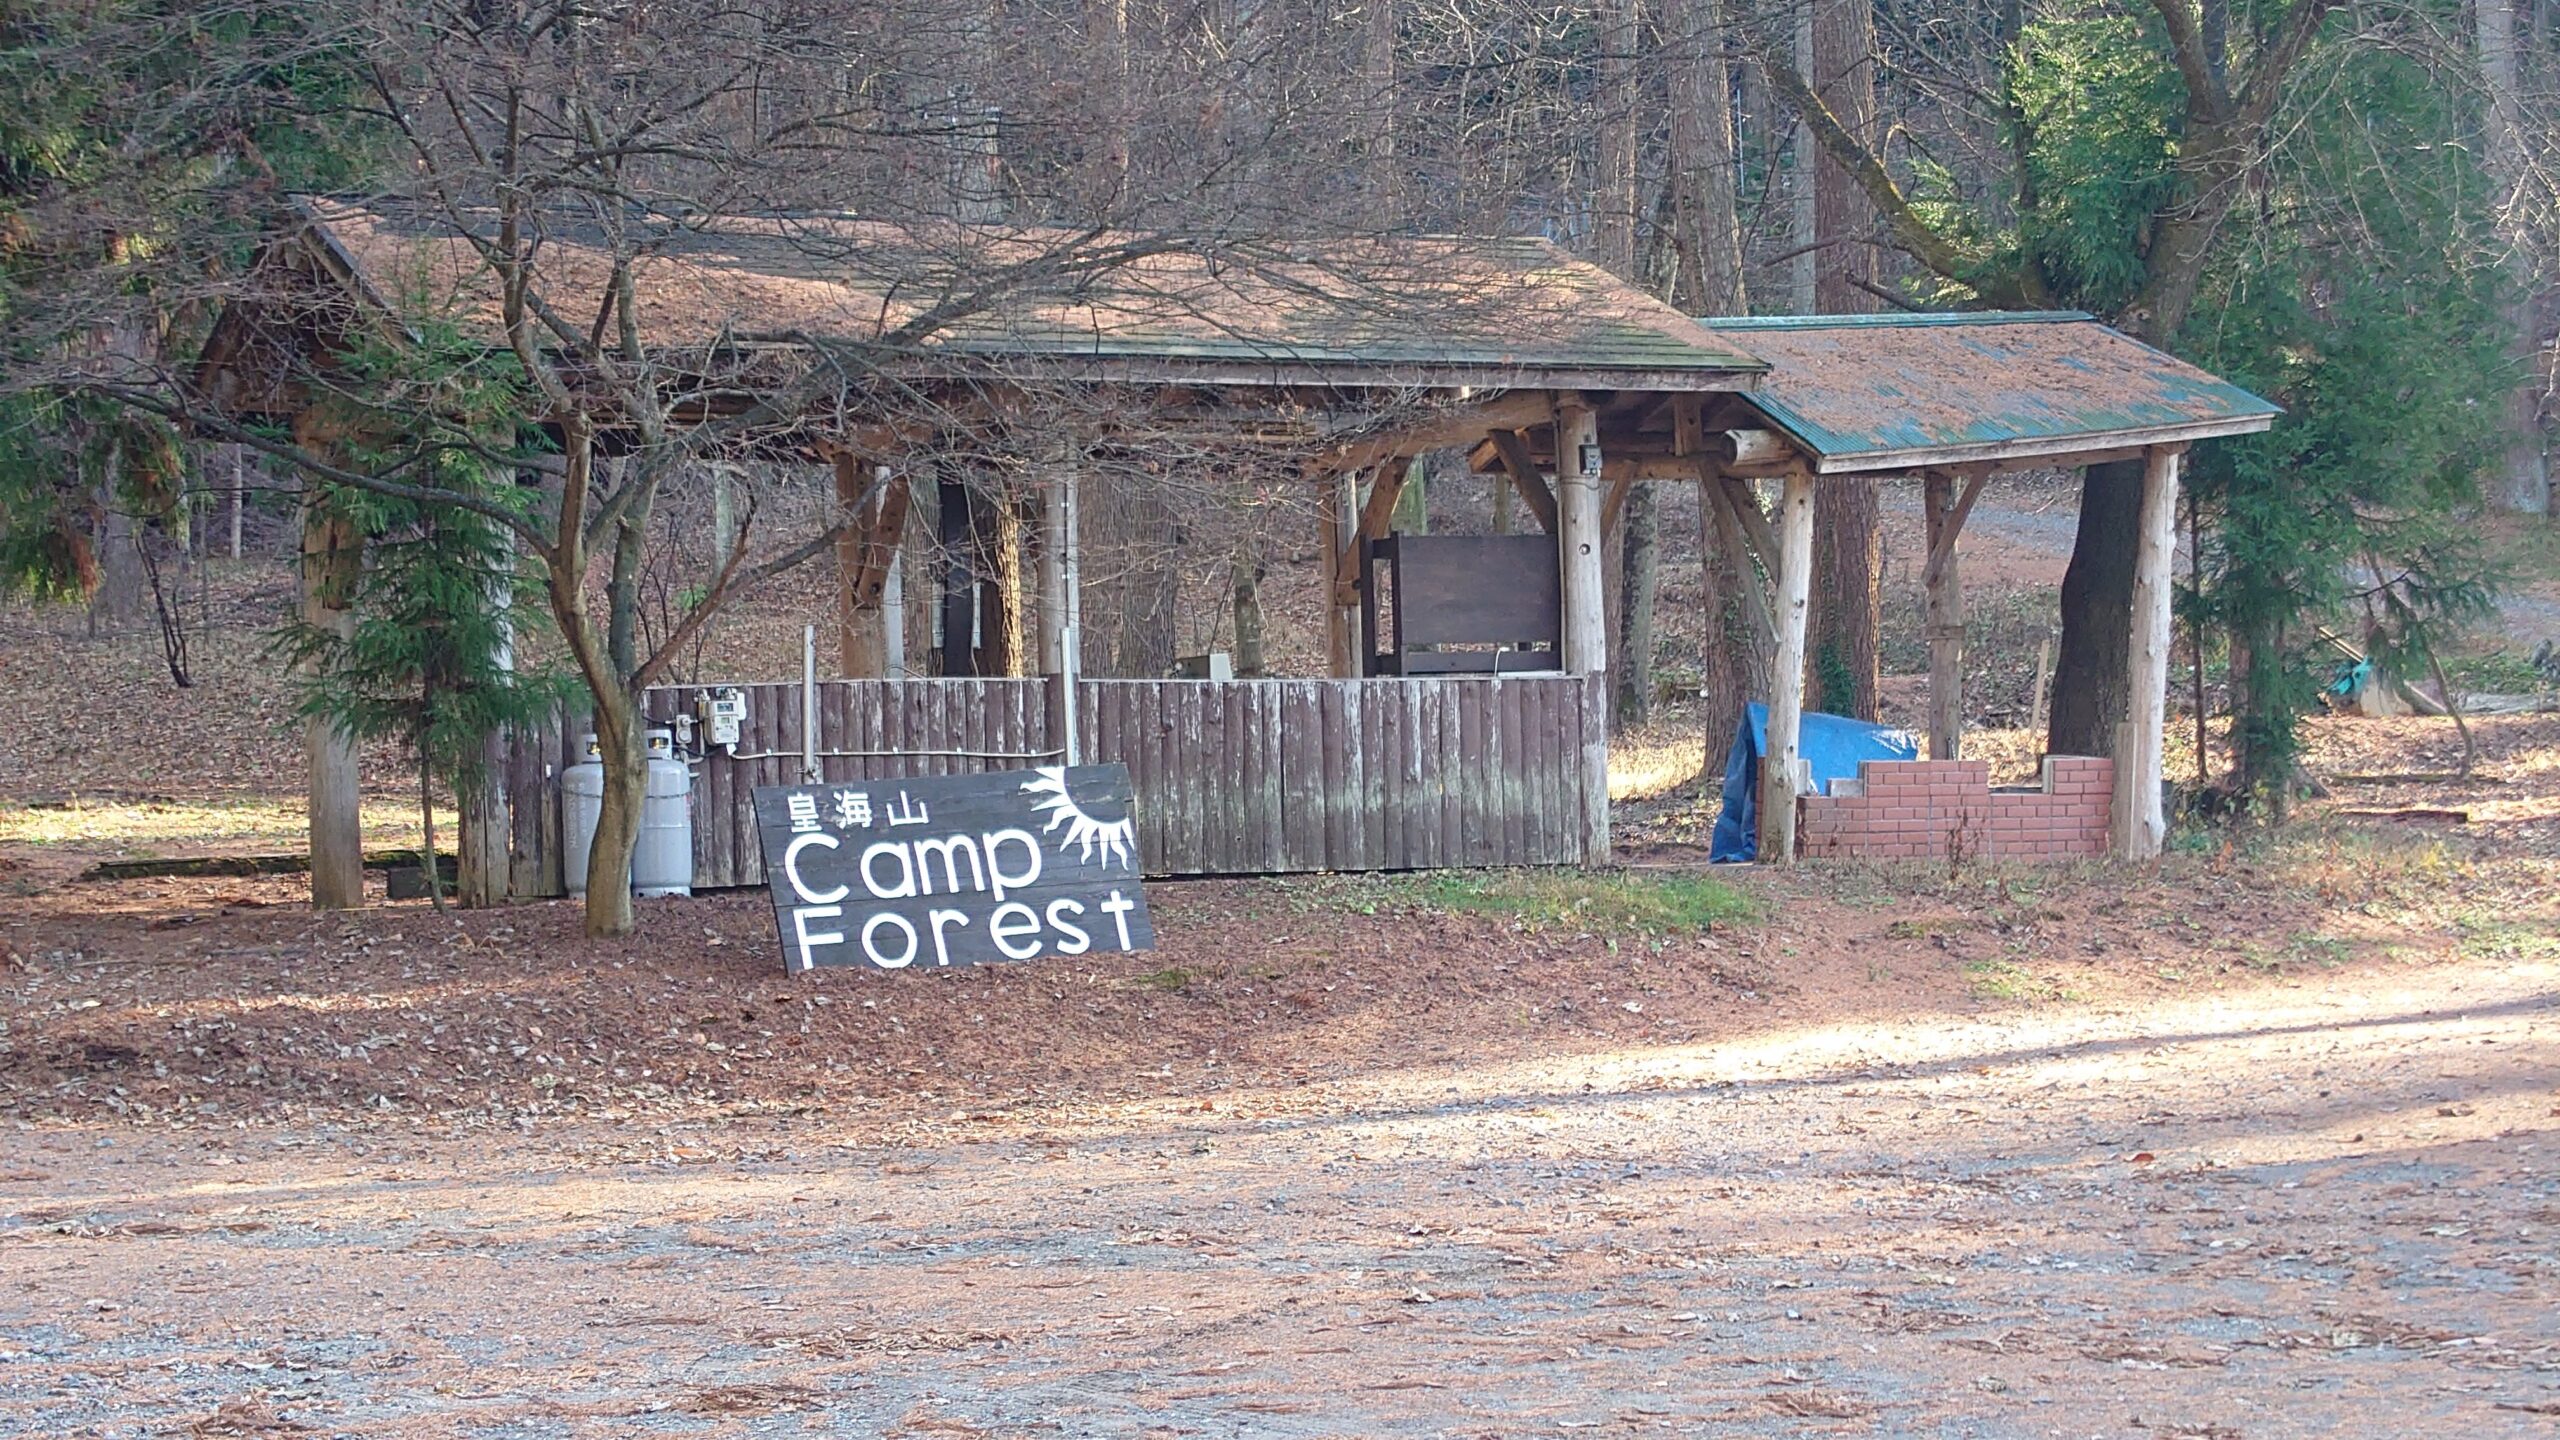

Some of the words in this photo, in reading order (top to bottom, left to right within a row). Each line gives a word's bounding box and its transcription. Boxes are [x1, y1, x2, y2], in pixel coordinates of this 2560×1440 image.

[787, 790, 930, 833] 皇海山
[784, 829, 1042, 904] Camp
[793, 890, 1135, 970] Forest
